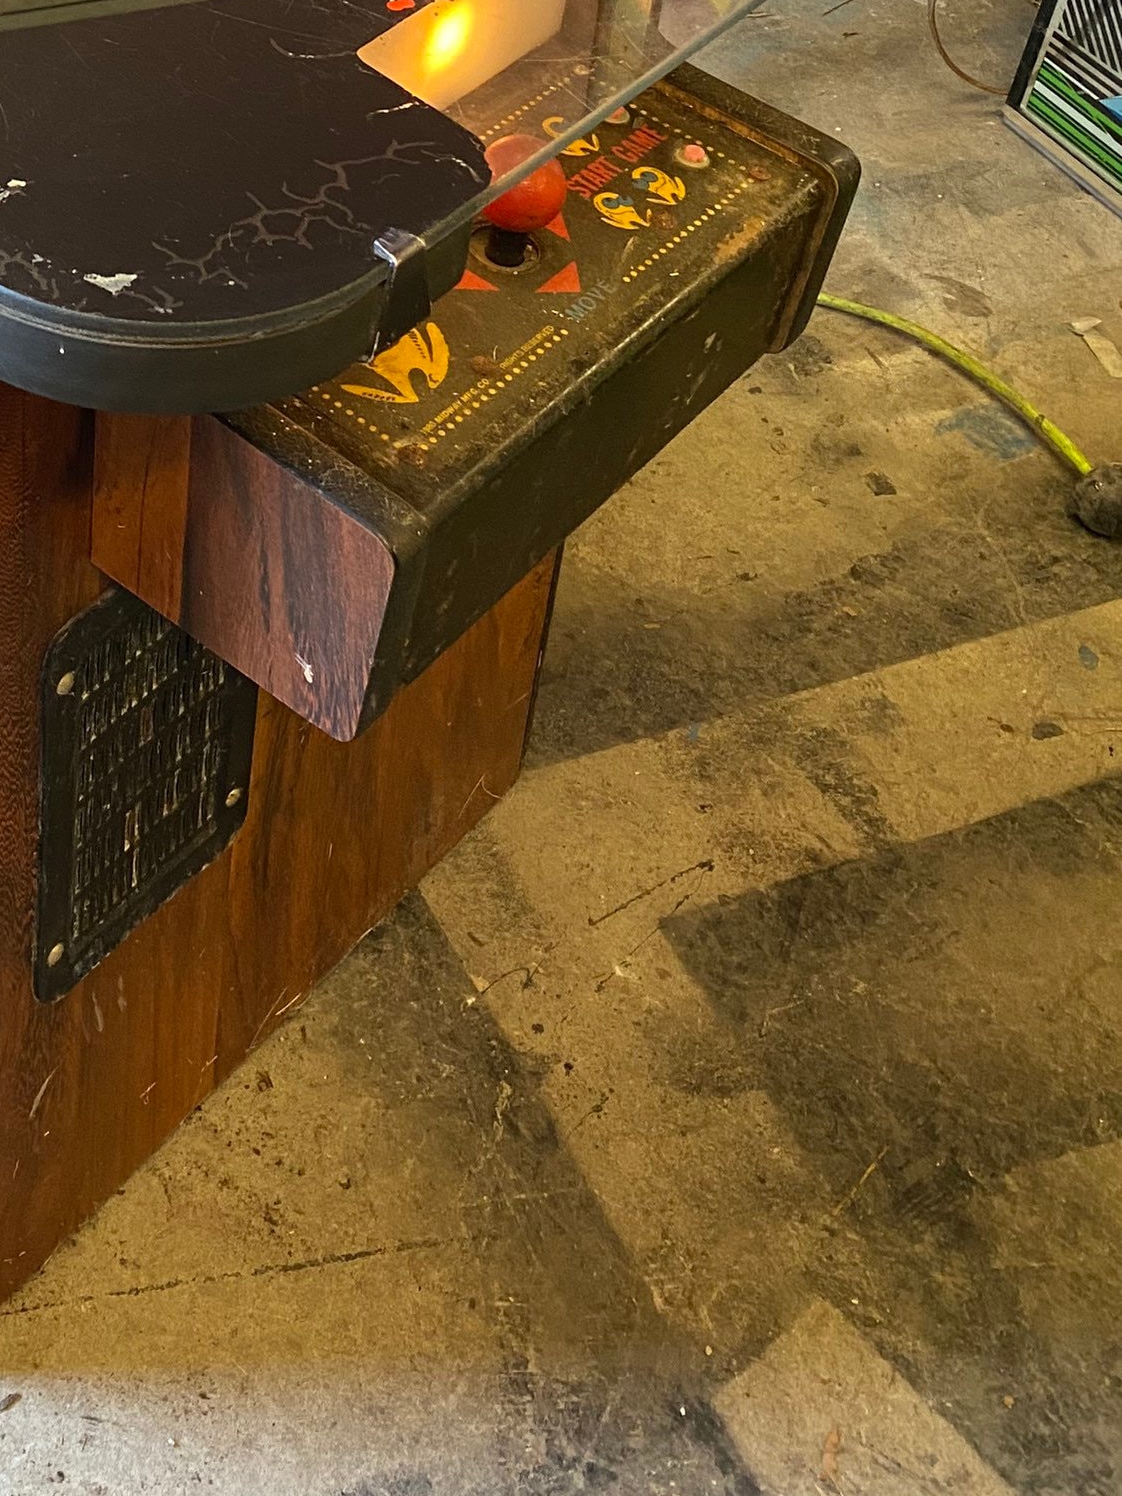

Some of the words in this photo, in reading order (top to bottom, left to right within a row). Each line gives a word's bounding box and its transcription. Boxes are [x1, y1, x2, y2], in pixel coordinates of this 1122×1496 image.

[567, 155, 623, 200] START
[611, 123, 668, 163] GAME
[564, 278, 619, 321] MOVE
[434, 399, 464, 424] MIDWAY
[500, 347, 526, 370] RIGHTS
[521, 325, 555, 352] RESERVED
